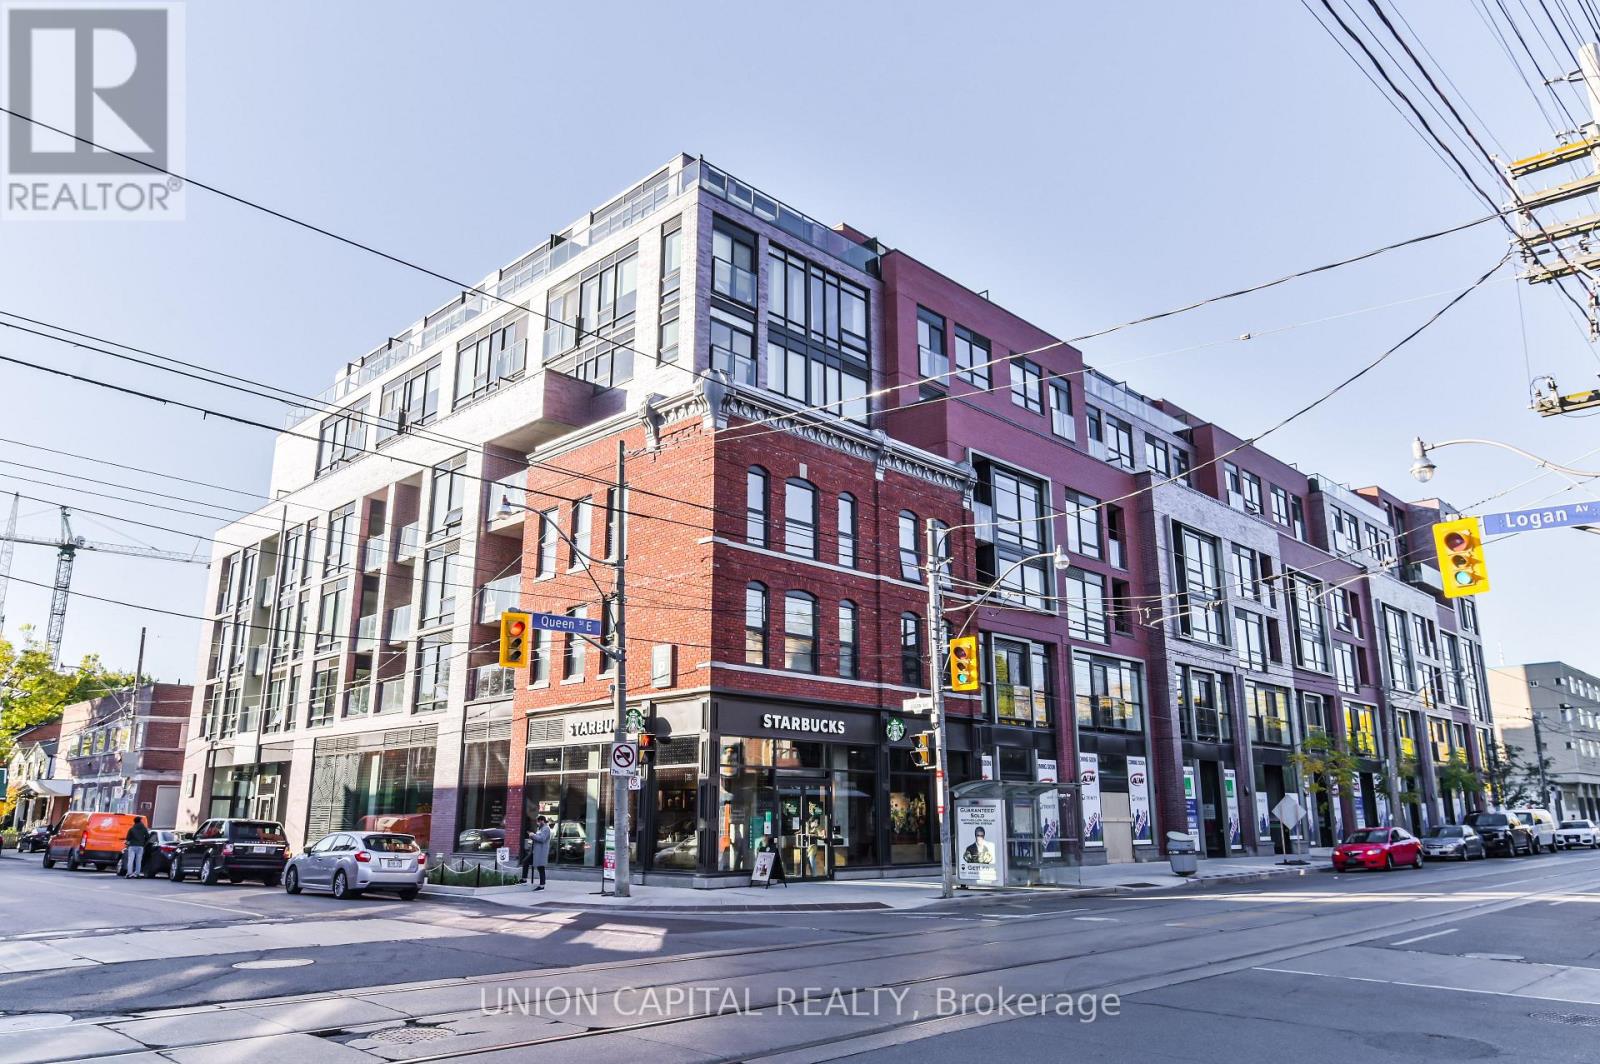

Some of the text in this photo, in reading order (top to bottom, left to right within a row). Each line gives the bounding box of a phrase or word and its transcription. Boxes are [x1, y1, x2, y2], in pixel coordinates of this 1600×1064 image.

[1505, 504, 1589, 528] Logan Av
[541, 616, 575, 630] Queen
[586, 621, 593, 632] E
[568, 719, 616, 737] STARBU
[763, 713, 846, 734] STARBUCKS
